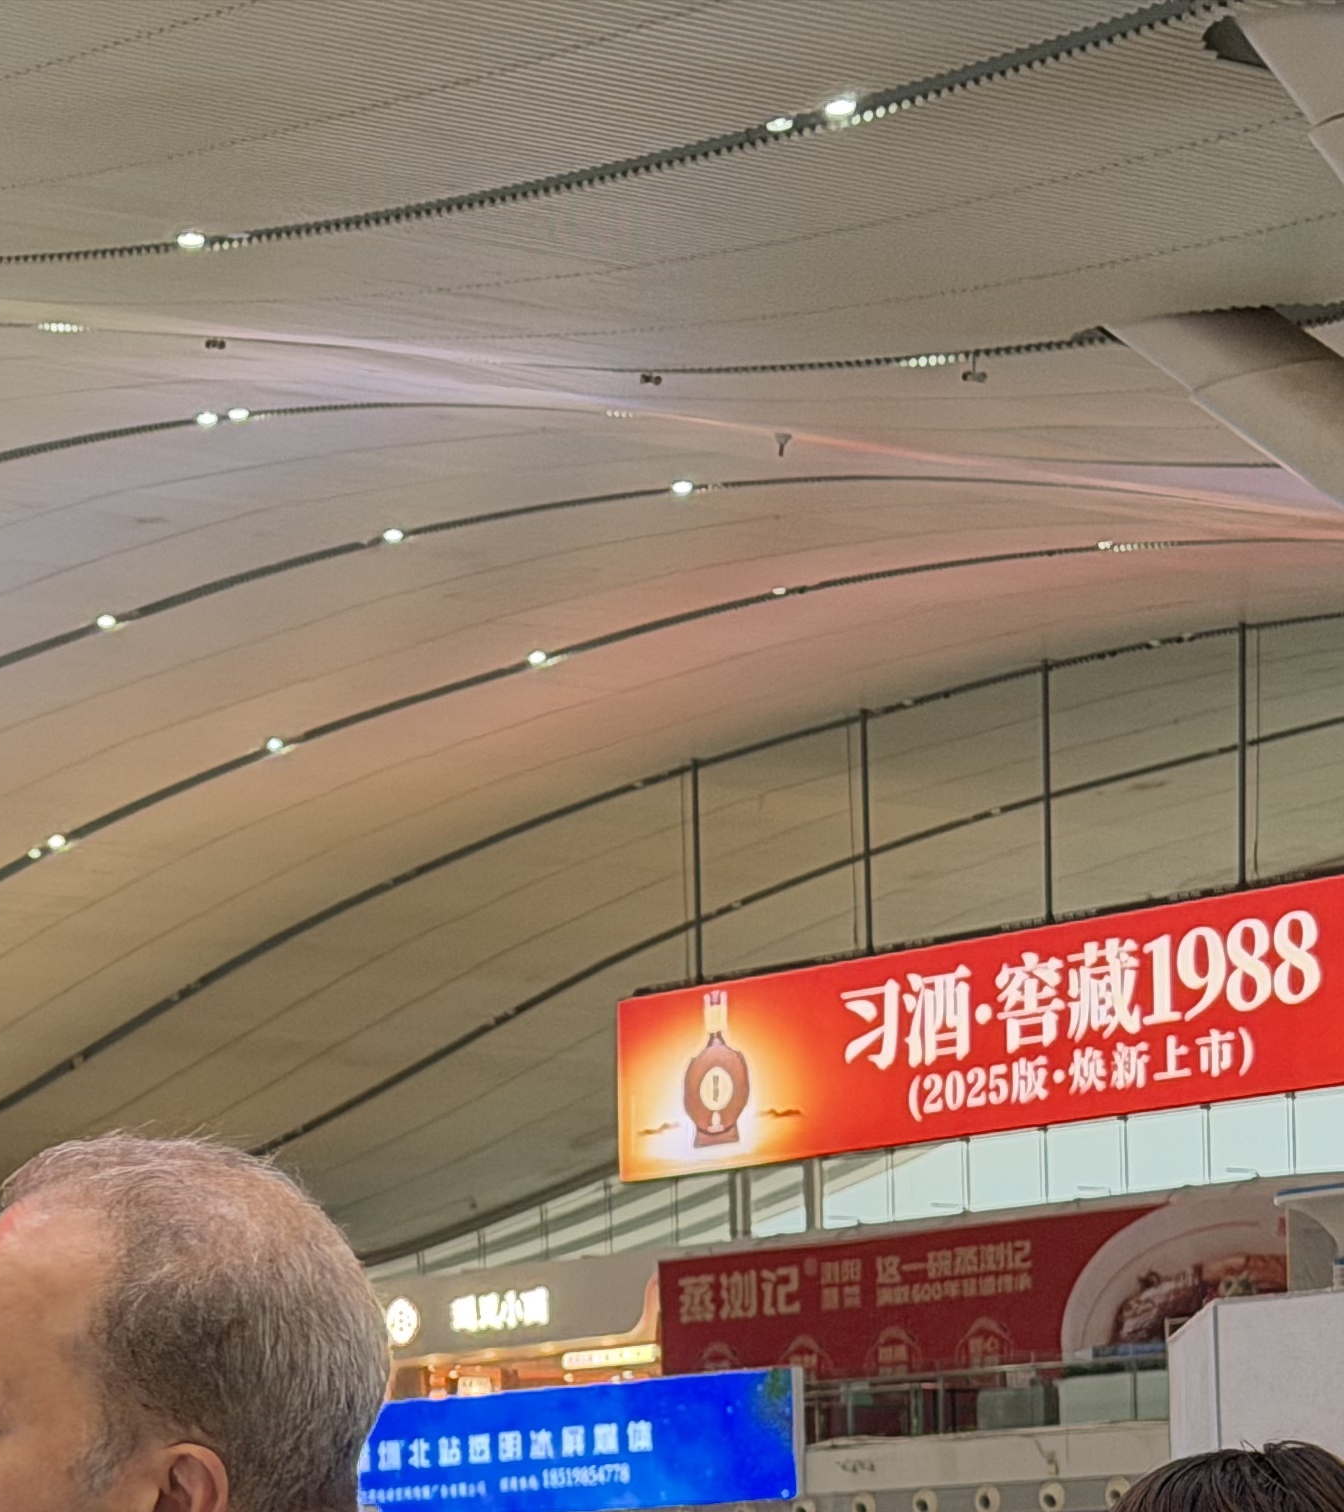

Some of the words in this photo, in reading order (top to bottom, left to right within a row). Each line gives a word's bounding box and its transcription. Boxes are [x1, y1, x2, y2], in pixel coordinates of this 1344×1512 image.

[840, 909, 1321, 1070] 习酒·窖藏1988
[908, 1026, 1255, 1123] (2025版·焕新上市)
[678, 1266, 801, 1323] 蒸浏记
